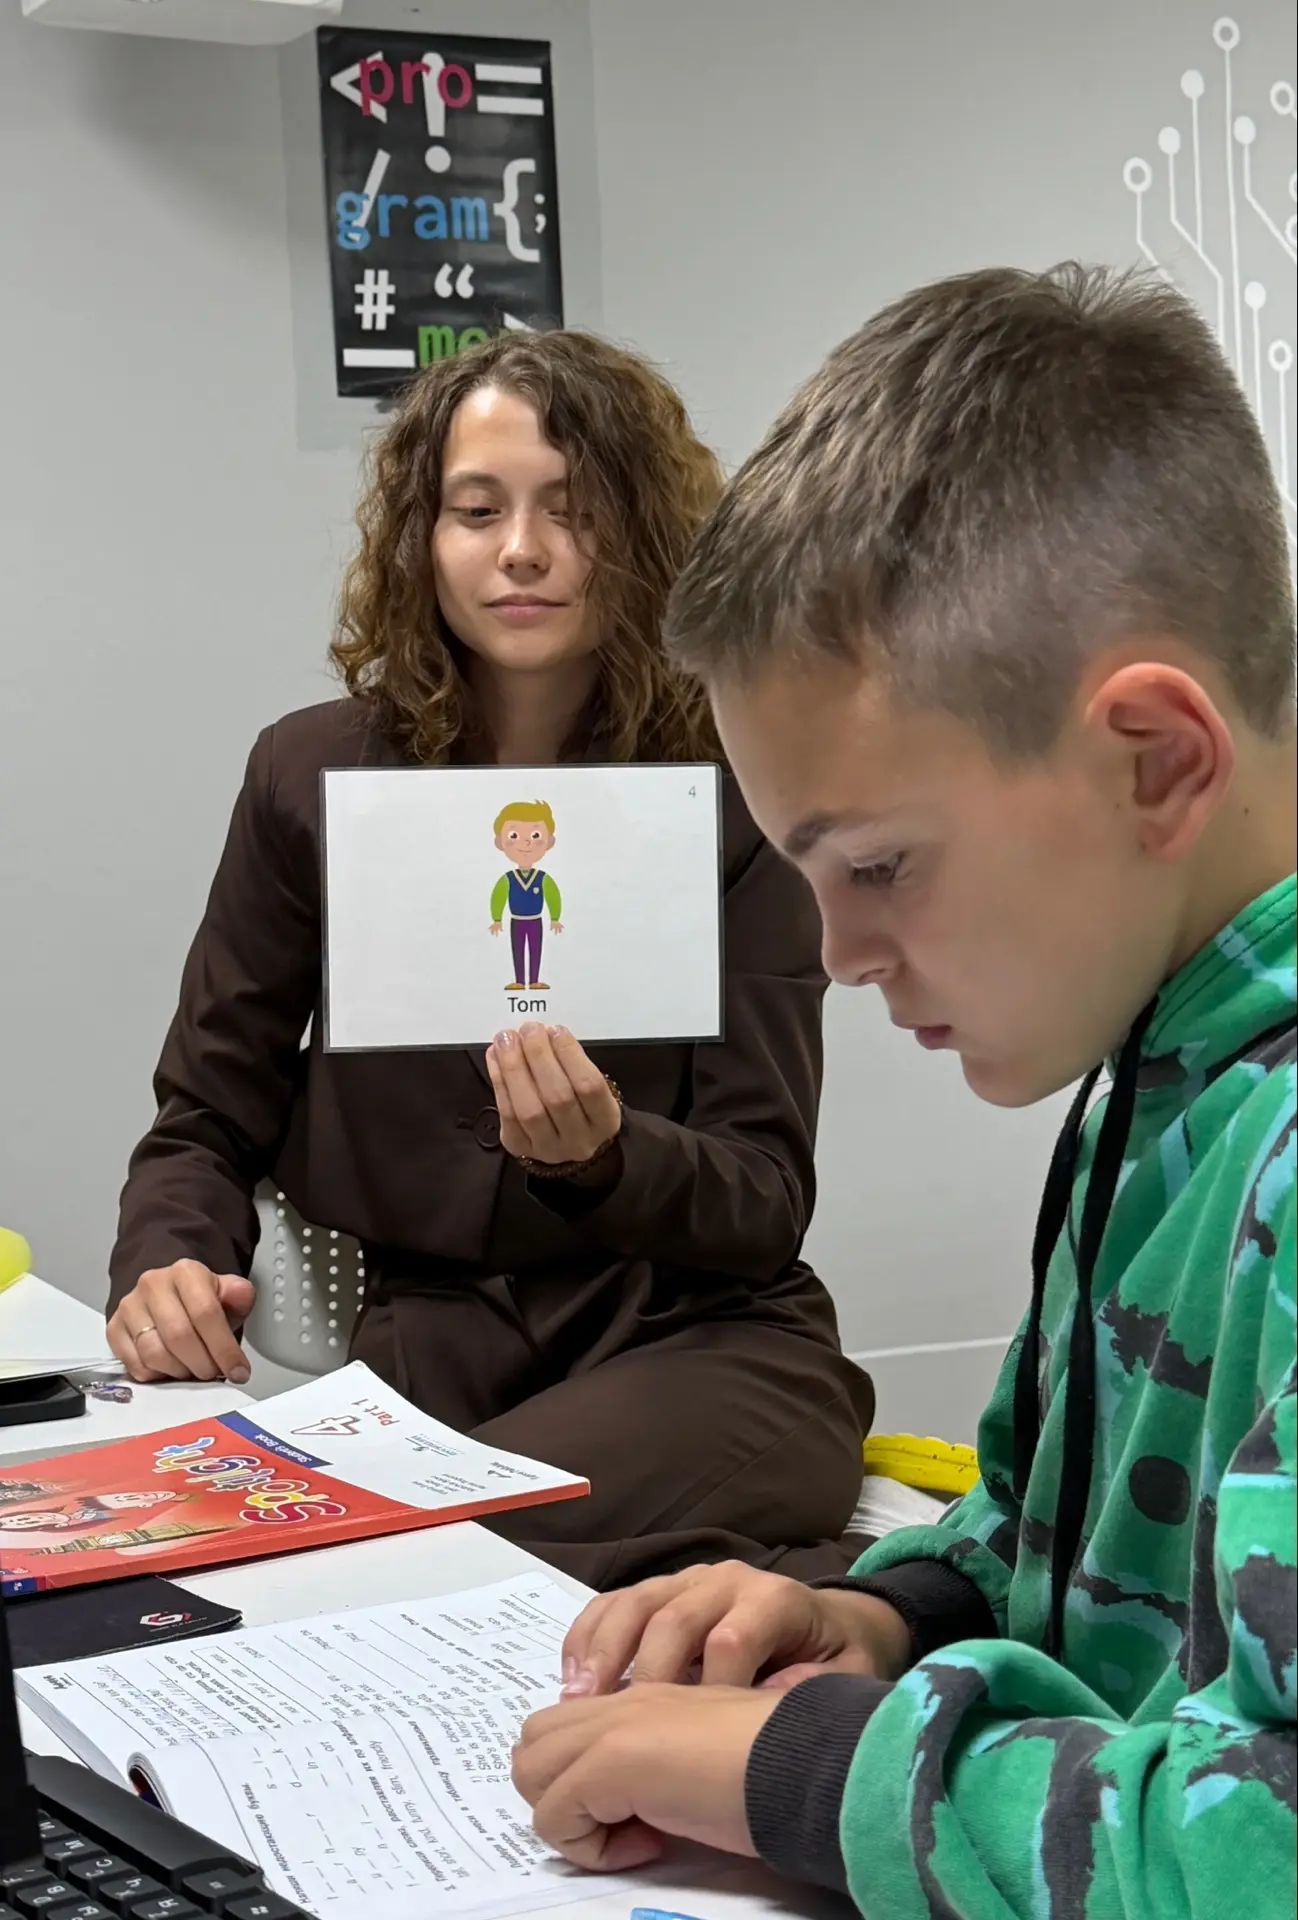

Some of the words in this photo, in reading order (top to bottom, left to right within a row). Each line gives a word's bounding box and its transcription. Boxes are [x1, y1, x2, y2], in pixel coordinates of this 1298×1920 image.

[359, 57, 473, 117] pro
[335, 189, 490, 251] gram
[688, 784, 696, 799] 4
[507, 997, 547, 1013] Tom
[350, 1398, 369, 1406] 1
[290, 1415, 362, 1436] 4
[364, 1404, 400, 1427] Part
[151, 1435, 347, 1525] Spotlight
